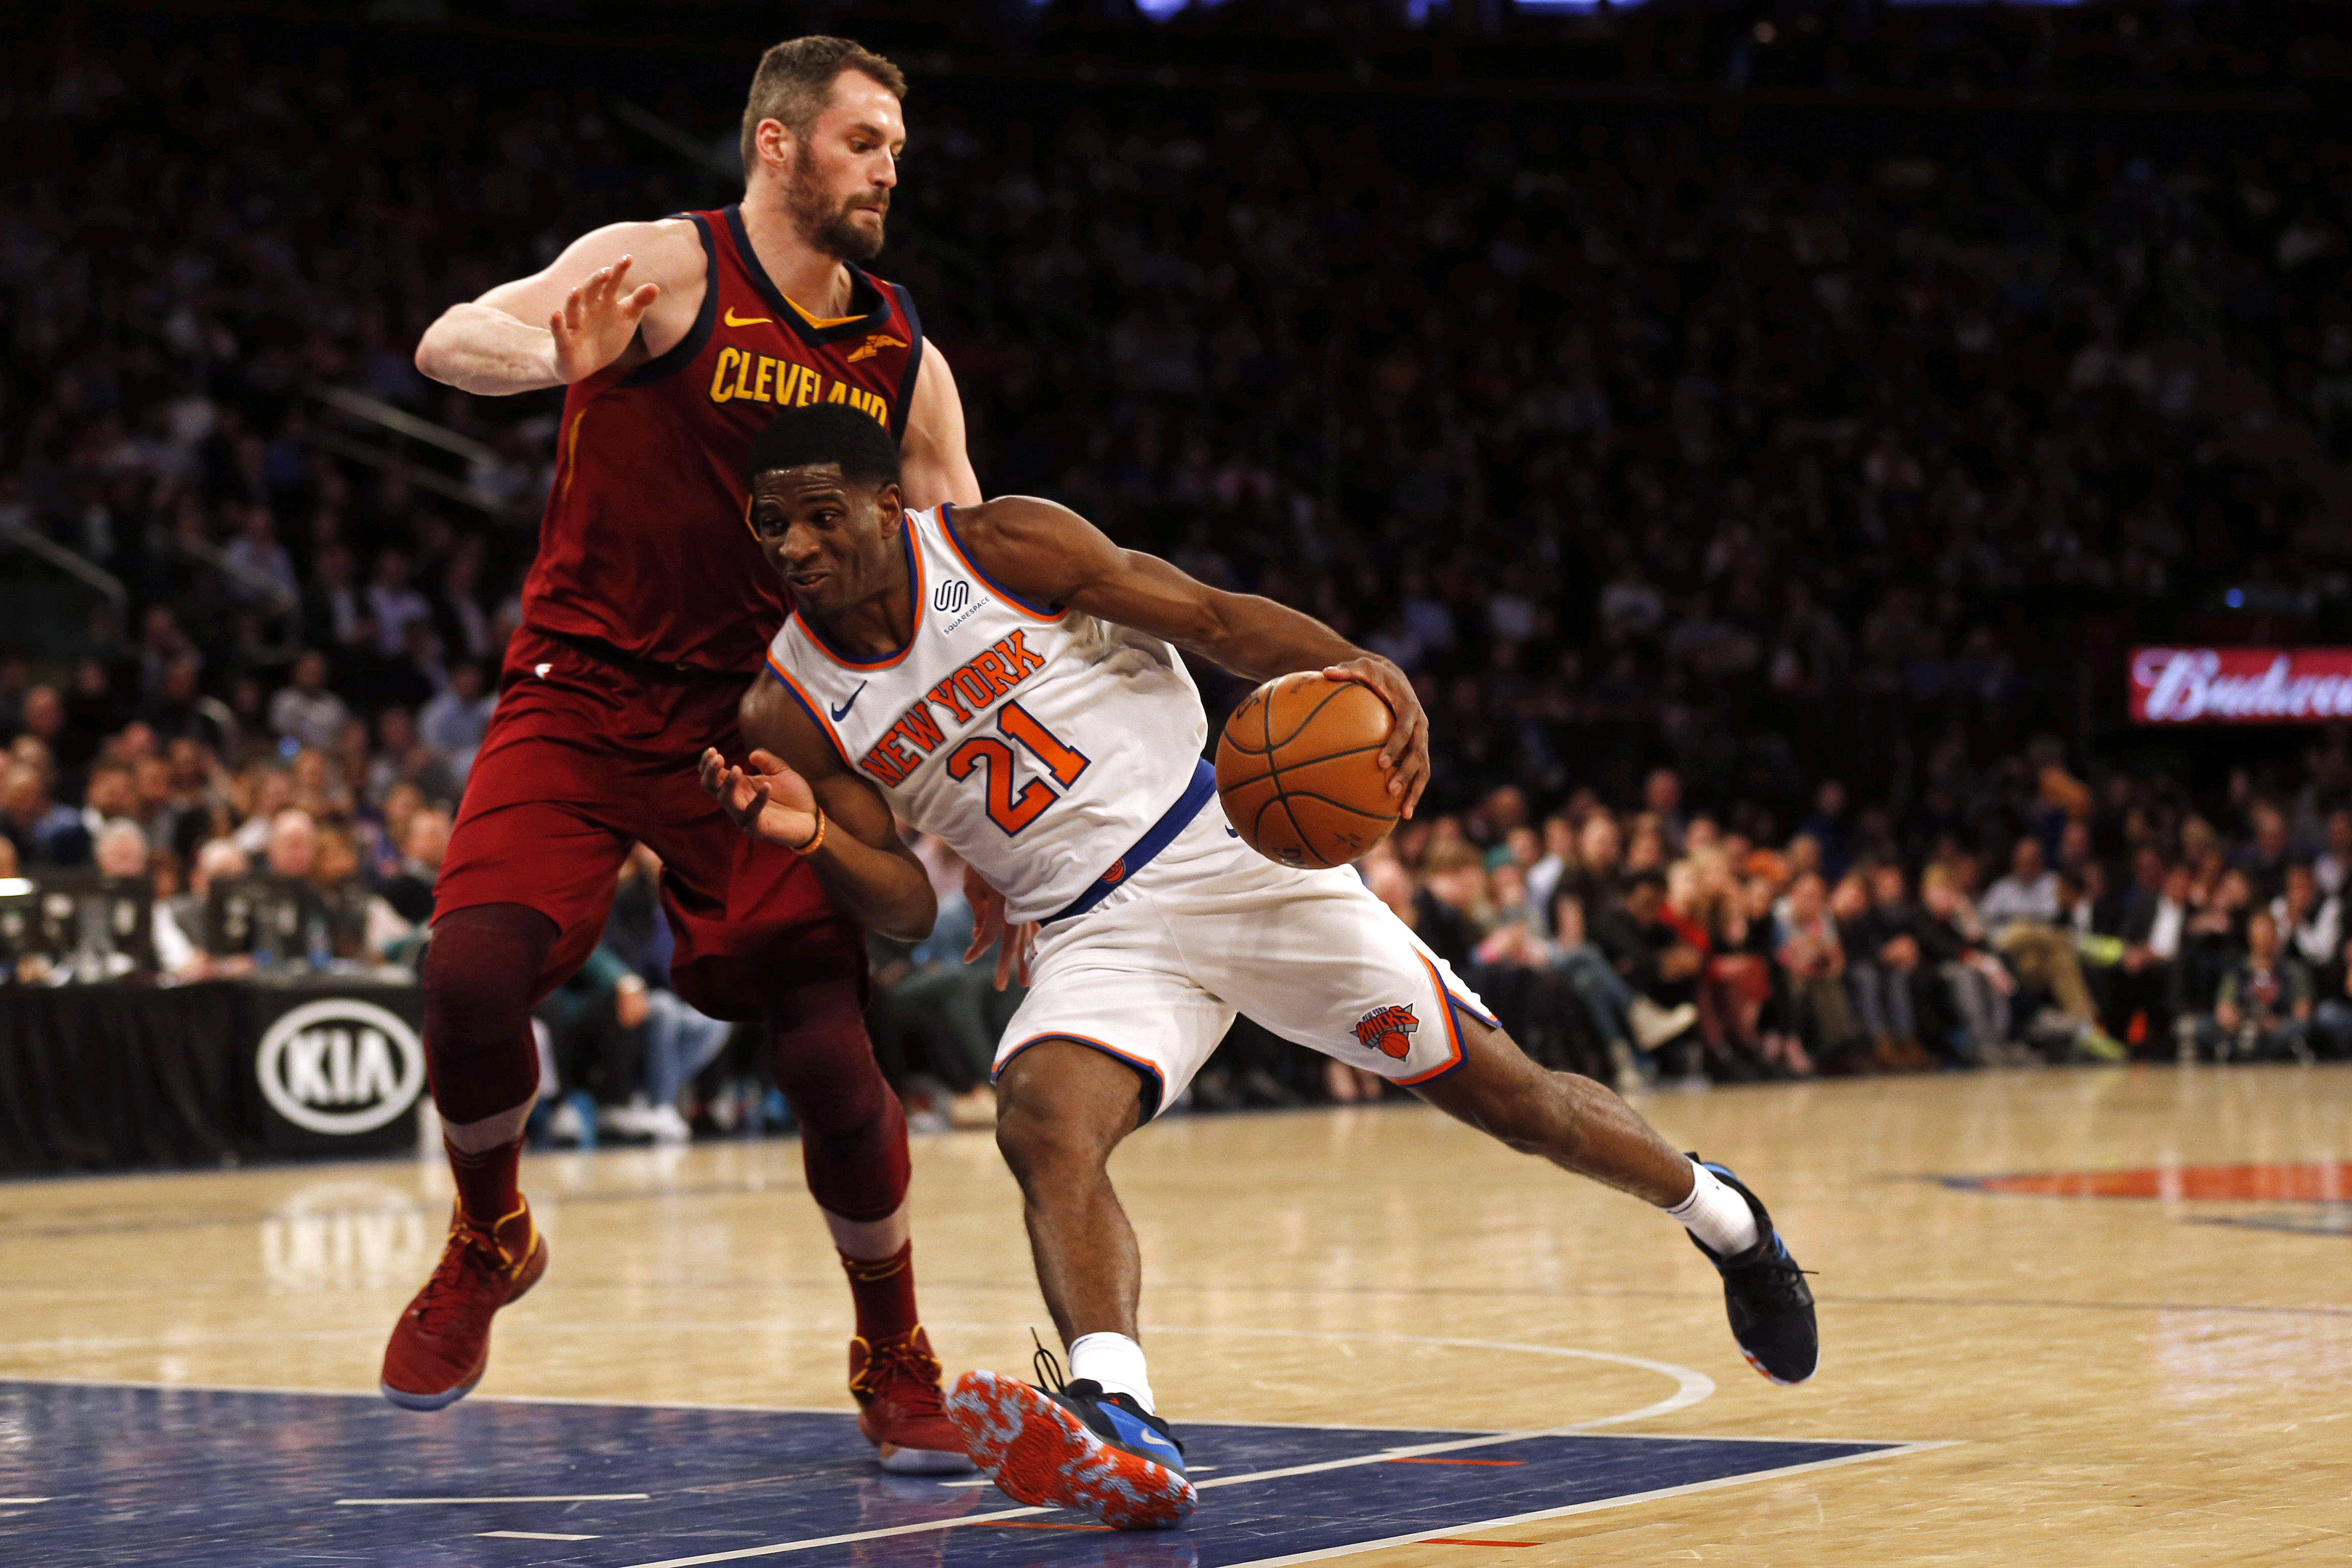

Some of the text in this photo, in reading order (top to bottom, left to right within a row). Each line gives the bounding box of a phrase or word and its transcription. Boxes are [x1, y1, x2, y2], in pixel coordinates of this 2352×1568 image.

[944, 596, 990, 635] SQUARESPACE
[859, 629, 1046, 788] NEW YORK
[946, 699, 1092, 838] 21
[1356, 1006, 1419, 1046] KNICKS
[286, 1027, 397, 1105] KIA
